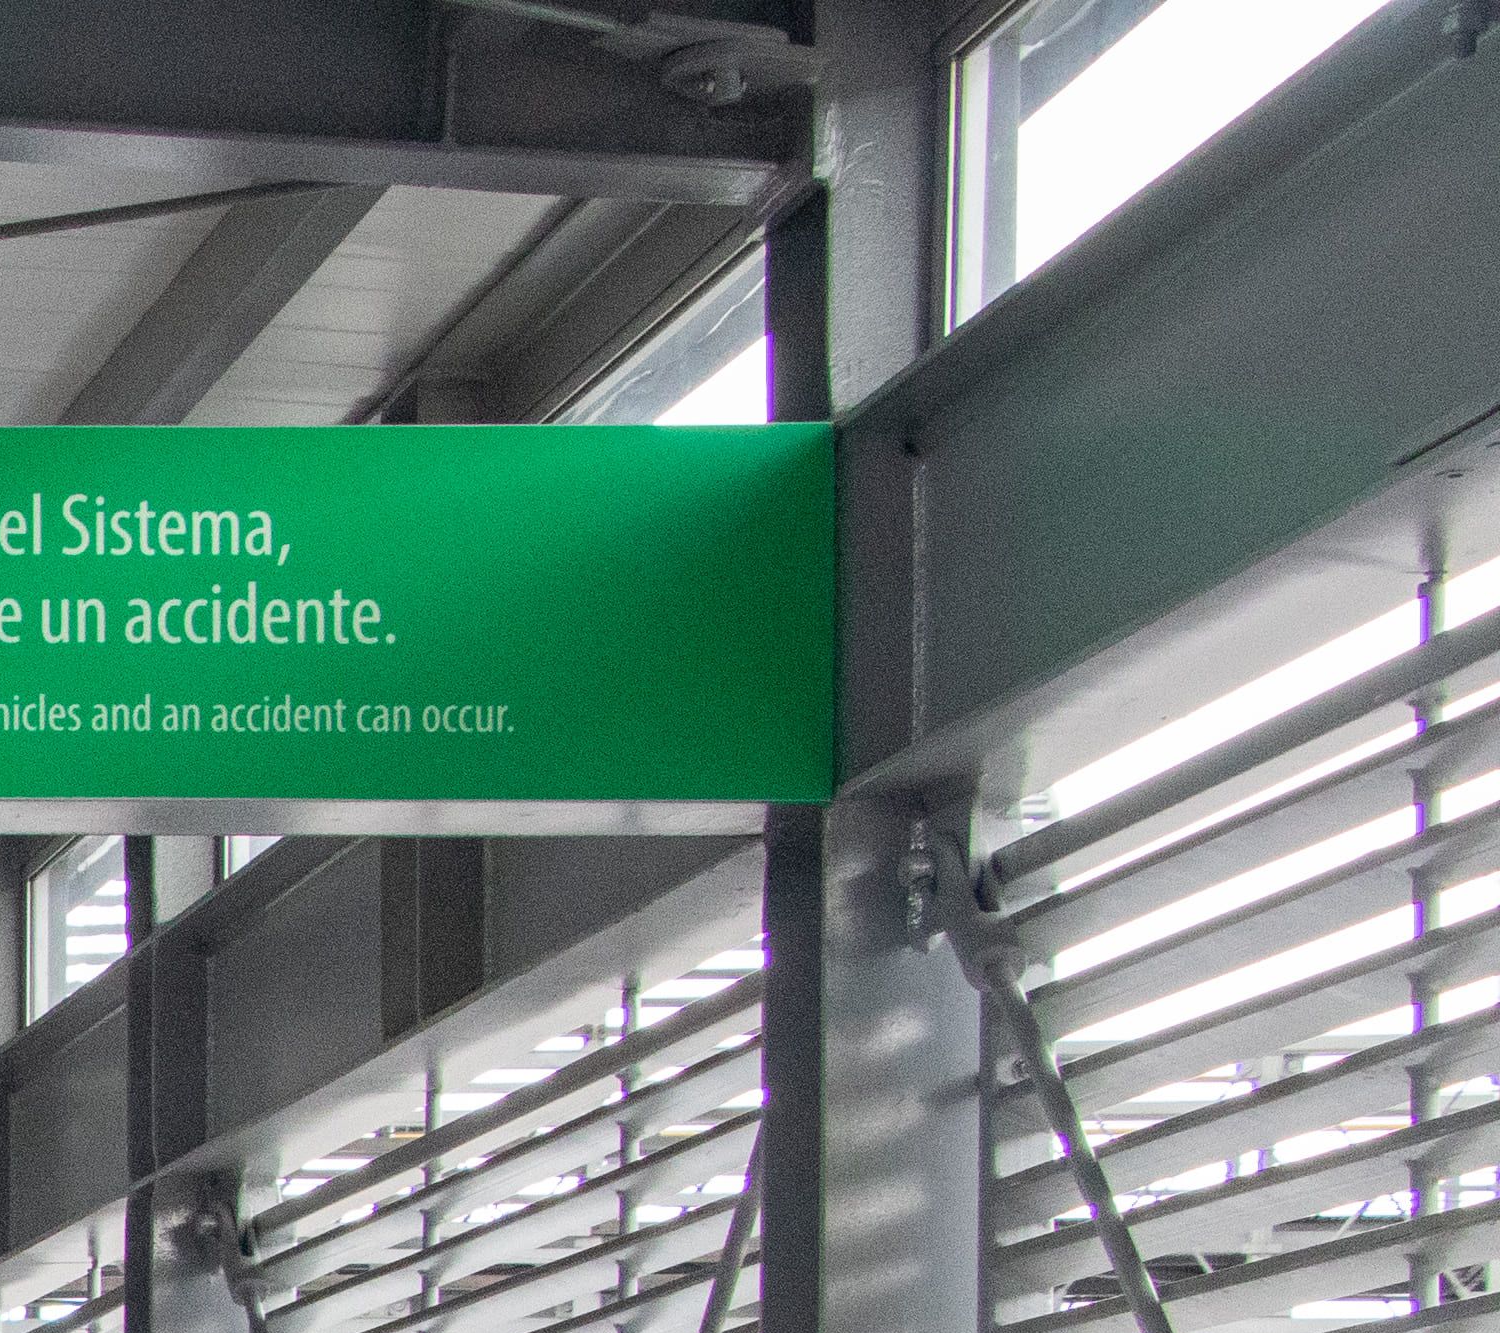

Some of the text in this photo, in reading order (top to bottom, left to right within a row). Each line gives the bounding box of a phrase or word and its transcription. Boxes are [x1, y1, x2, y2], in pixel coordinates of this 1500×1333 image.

[62, 493, 290, 566] Sistema,
[41, 598, 106, 644] un
[125, 581, 396, 644] accidente.
[91, 693, 151, 731] and
[162, 704, 201, 732] an
[211, 694, 346, 732] accident
[357, 705, 411, 732] can
[423, 705, 515, 732] occur.
